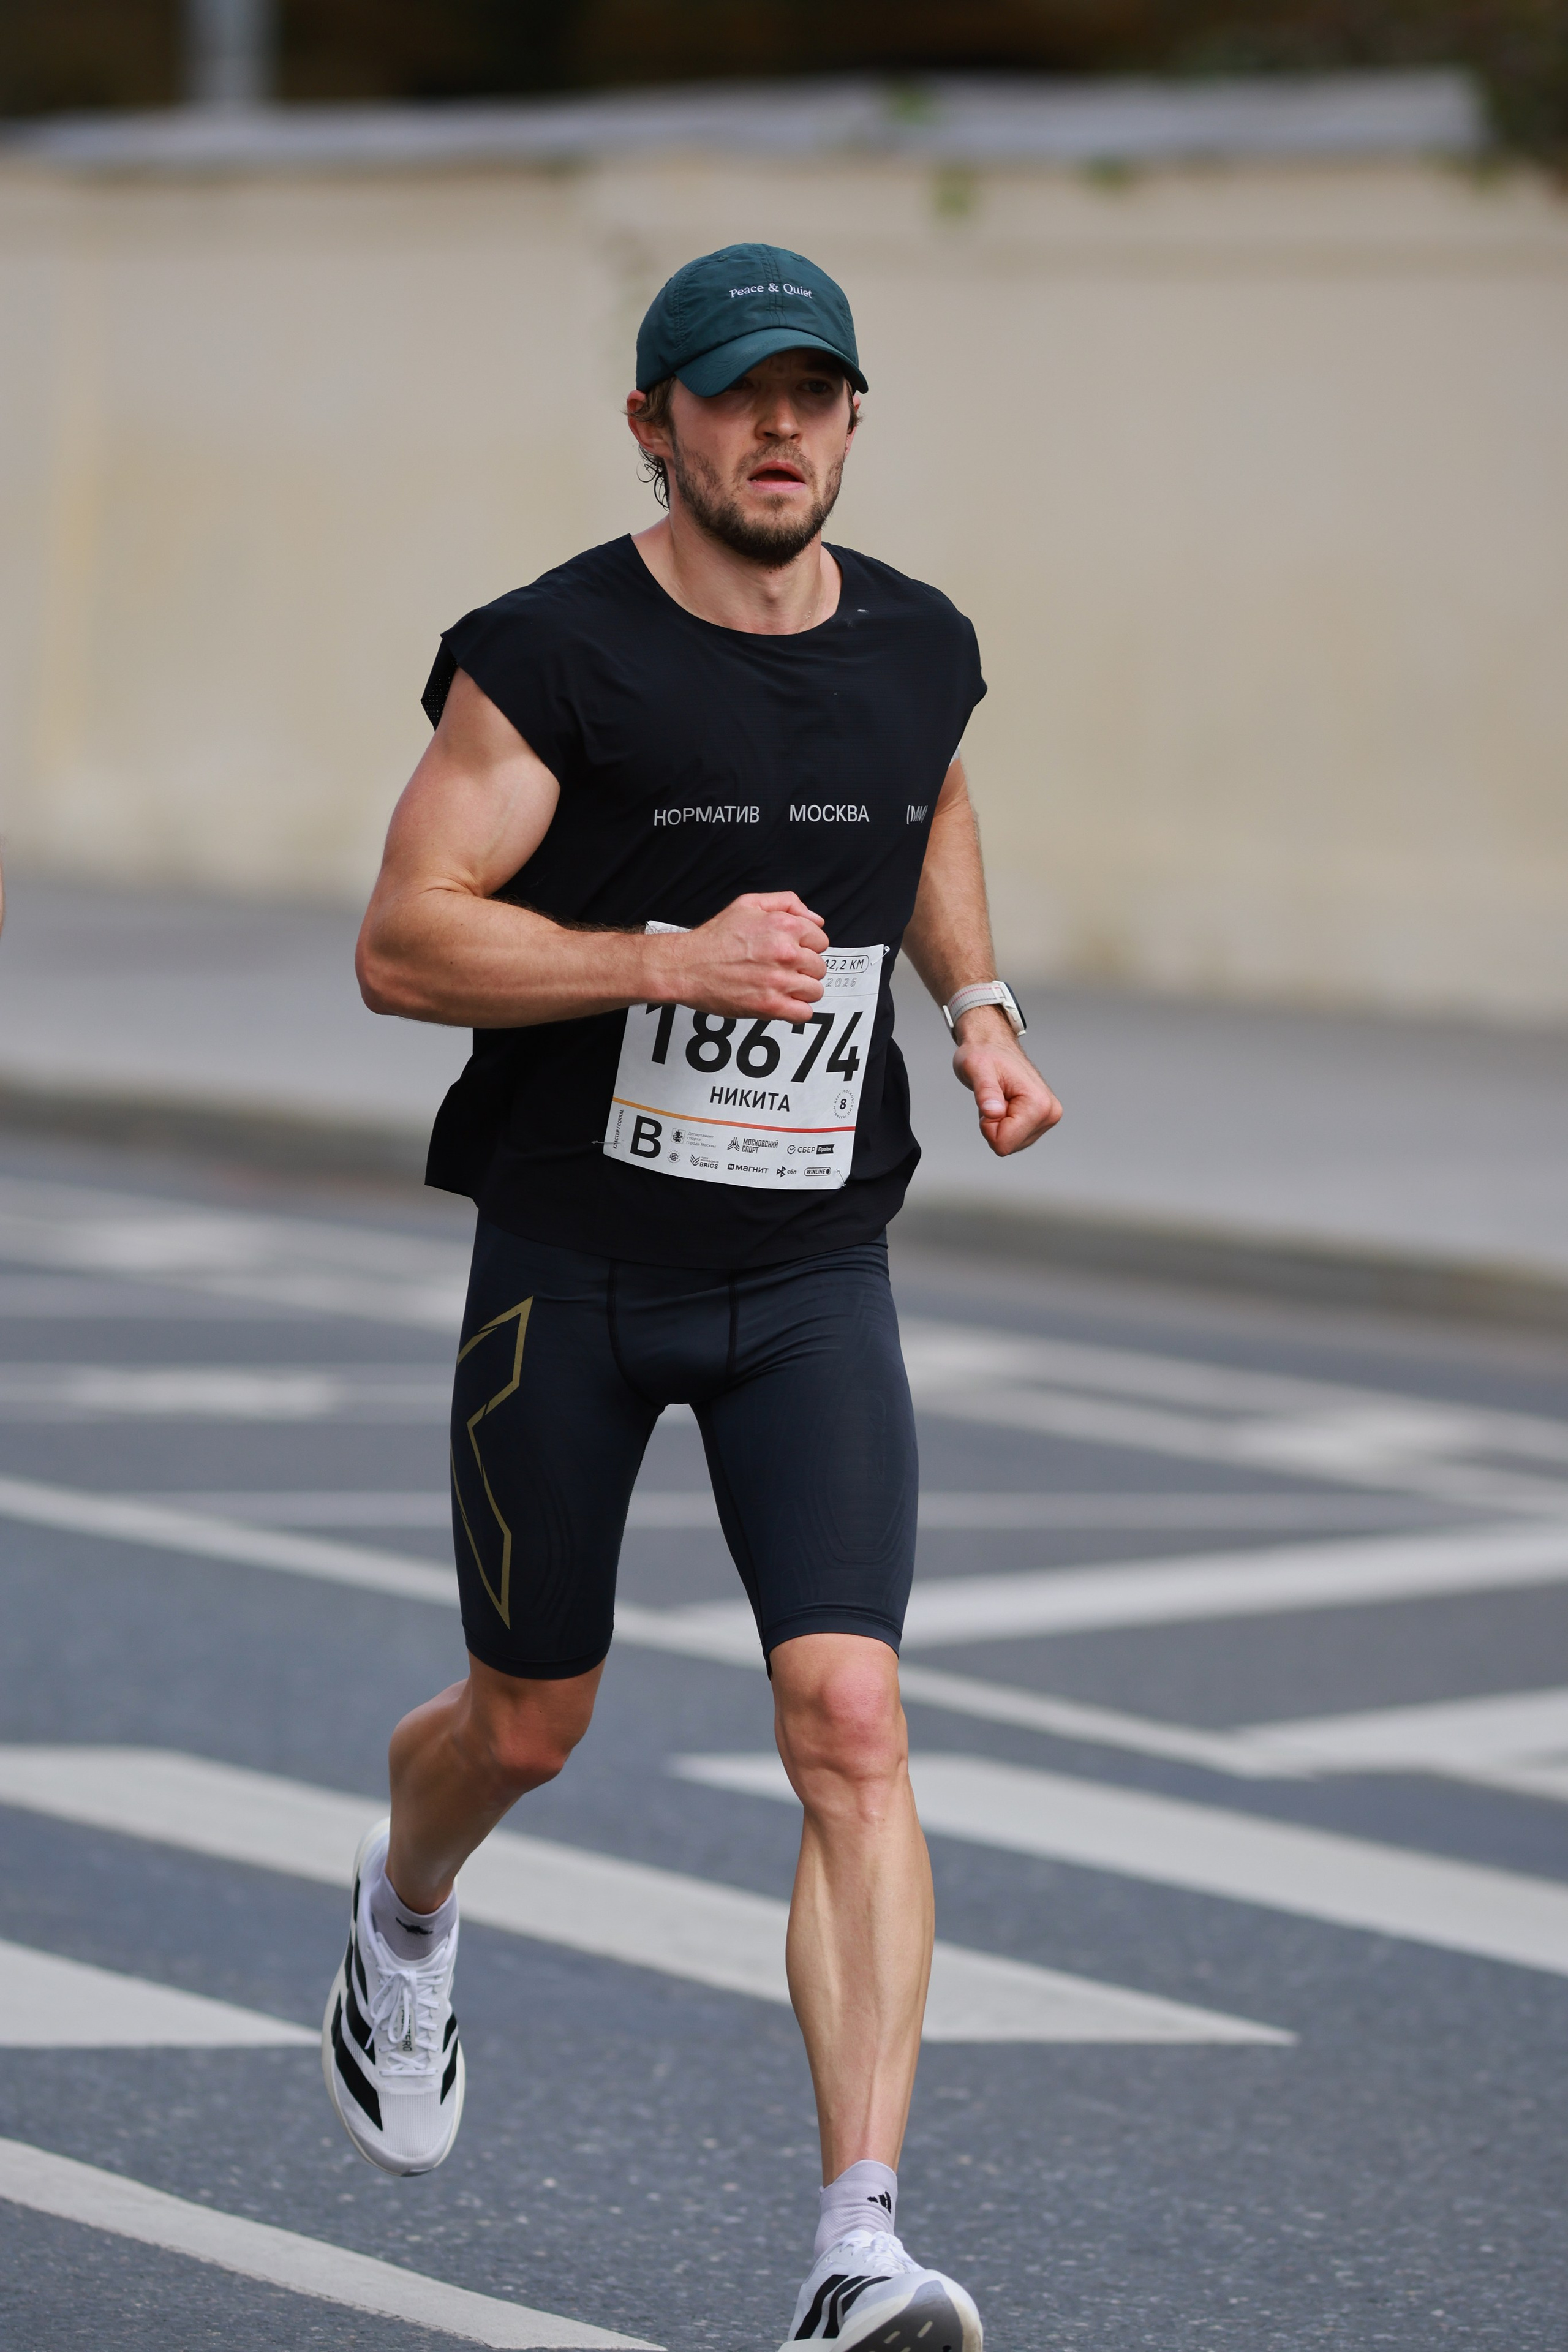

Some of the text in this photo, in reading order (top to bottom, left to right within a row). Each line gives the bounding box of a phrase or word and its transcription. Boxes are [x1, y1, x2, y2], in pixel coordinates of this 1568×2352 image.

[729, 282, 813, 299] Peace & Quiet
[654, 805, 760, 826] НОРМАТИВ
[790, 804, 870, 823] МОСКВА
[825, 977, 858, 988] 2026
[645, 1003, 864, 1084] 18674
[709, 1085, 790, 1112] НИКИТА
[840, 1098, 846, 1109] 8
[630, 1115, 663, 1159] B
[742, 1137, 778, 1148] МОСКОВСКИЙ
[741, 1145, 759, 1154] СПОРТ
[735, 1164, 769, 1174] магнит
